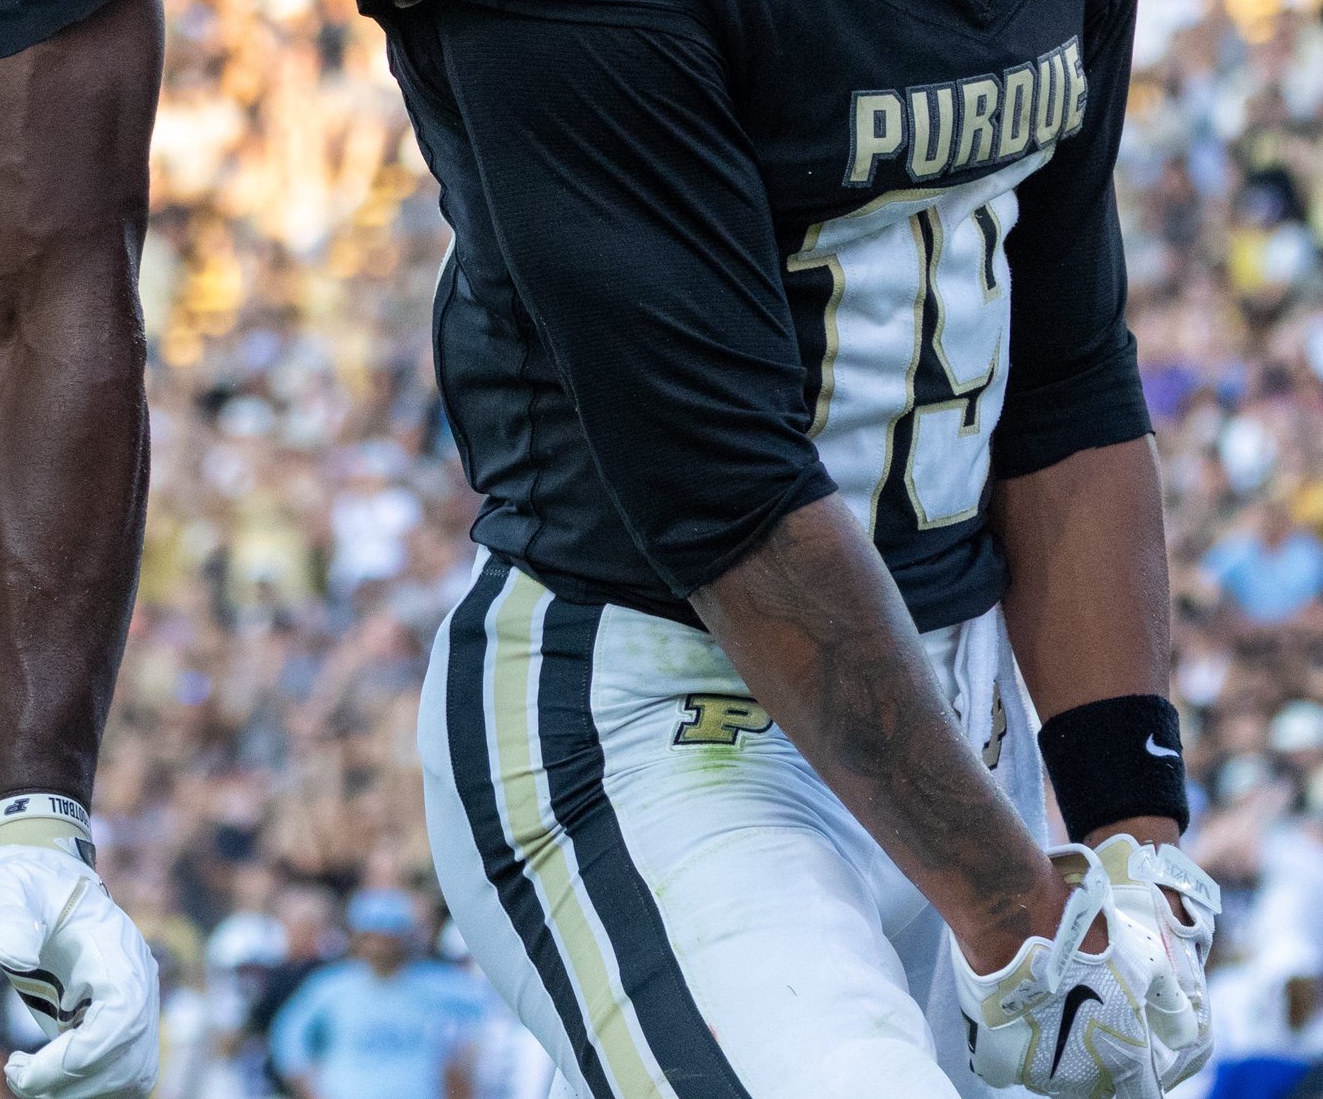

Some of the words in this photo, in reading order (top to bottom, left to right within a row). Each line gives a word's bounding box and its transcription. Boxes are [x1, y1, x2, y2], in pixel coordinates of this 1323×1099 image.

[841, 34, 1088, 188] PURDUE
[787, 148, 1053, 544] 19
[672, 692, 774, 746] P
[4, 797, 31, 816] P
